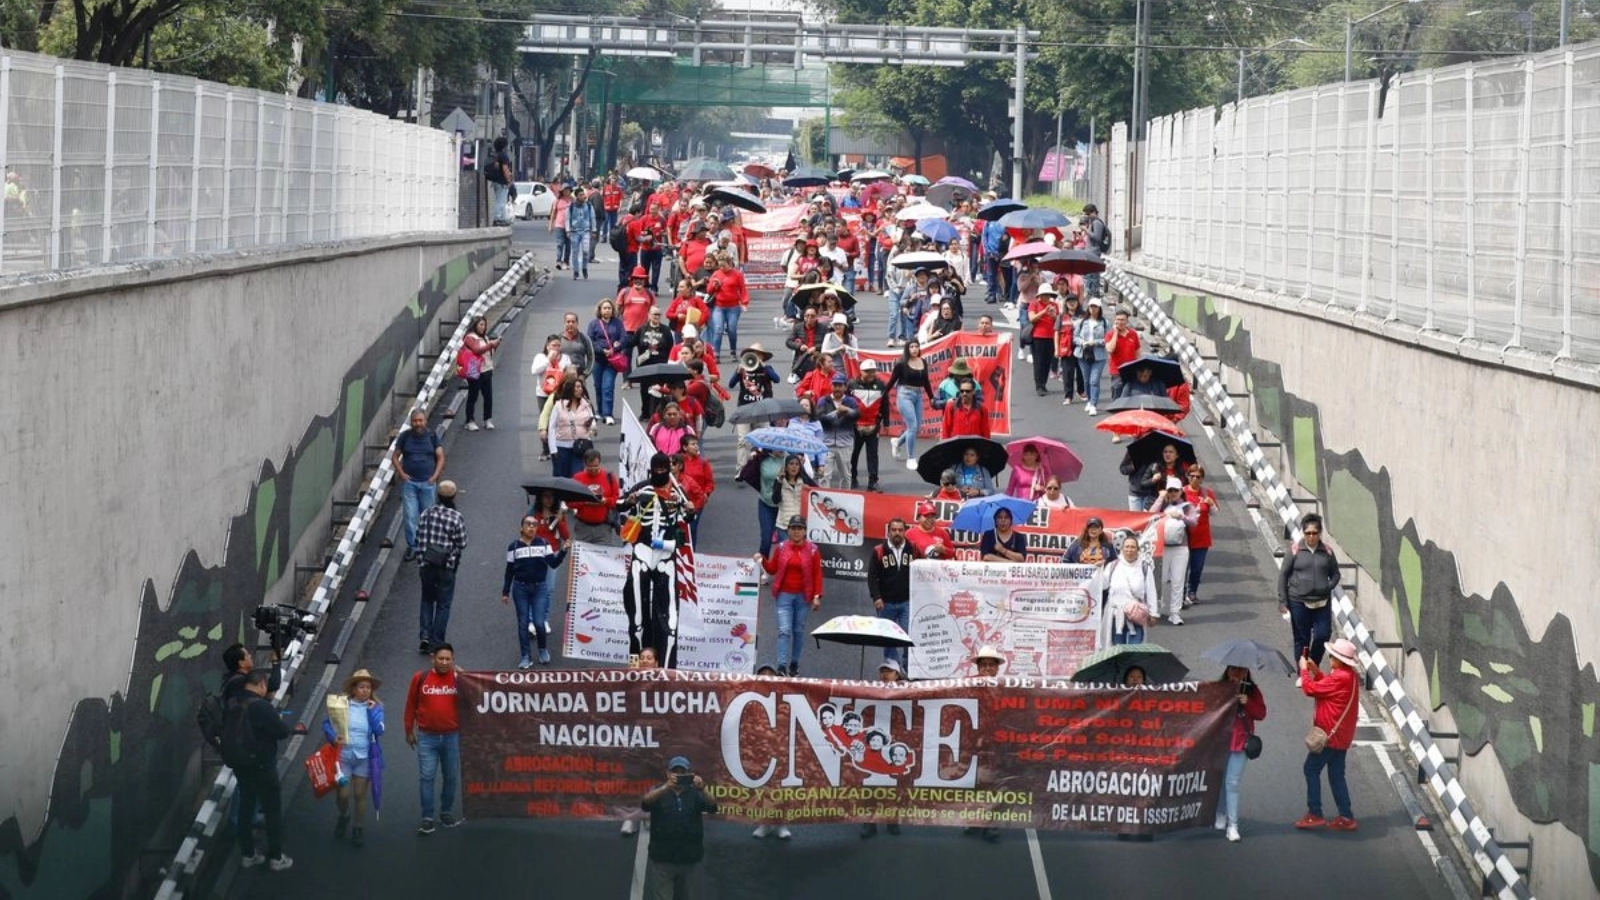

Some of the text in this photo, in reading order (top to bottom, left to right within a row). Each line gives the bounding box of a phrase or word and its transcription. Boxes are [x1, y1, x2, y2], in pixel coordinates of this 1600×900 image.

[809, 528, 855, 545] CNTE
[854, 558, 864, 571] 9
[962, 564, 983, 577] Escuela
[1001, 578, 1033, 586] Matutino
[581, 648, 611, 659] Comité
[613, 651, 624, 659] de
[697, 660, 721, 669] CNTE
[495, 669, 668, 685] COORDINADORA
[1003, 675, 1040, 690] DE
[1043, 677, 1071, 691] LA
[477, 690, 721, 714] JORNADA DE LUCHA
[1034, 697, 1086, 710] UMA
[1096, 698, 1120, 711] NI
[1127, 699, 1206, 713] AFORE
[1038, 715, 1162, 730] Regreso al
[539, 723, 659, 748] NACIONAL
[720, 691, 980, 788] CNTE
[993, 730, 1196, 748] Sistema Solidario
[1017, 747, 1046, 761] de
[504, 754, 594, 773] ABROGACIÓN
[533, 778, 594, 794] REFORMA
[1047, 768, 1208, 796] ABROGACIÓN TOTAL
[754, 789, 764, 801] Y
[770, 787, 901, 802] ORGANIZADOS,
[908, 788, 1033, 805] VENCEREMOS!
[746, 806, 783, 820] quien
[786, 804, 849, 821] gobierne,
[852, 803, 871, 816] los
[875, 802, 937, 819] derechos
[940, 809, 955, 819] se
[959, 807, 1032, 822] defienden!
[1051, 802, 1202, 824] DE LA LEY DEL ISSSTE 2007
